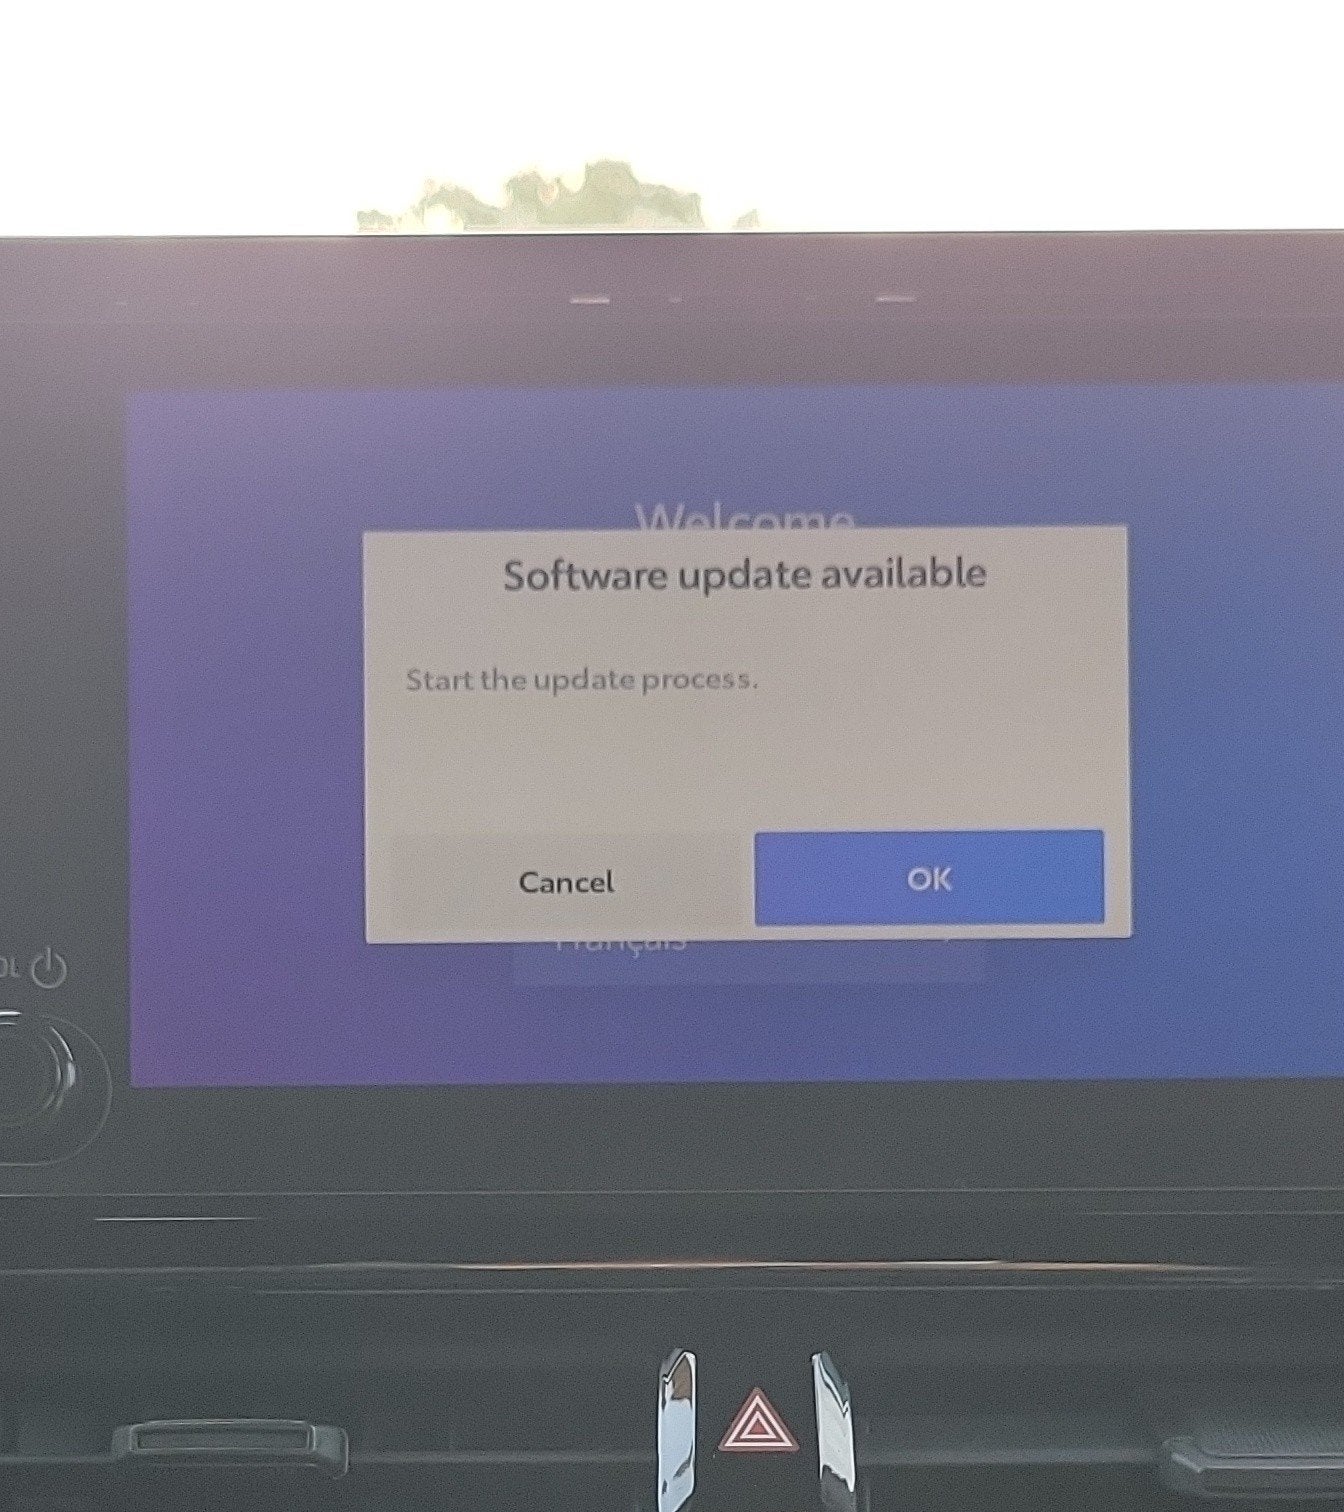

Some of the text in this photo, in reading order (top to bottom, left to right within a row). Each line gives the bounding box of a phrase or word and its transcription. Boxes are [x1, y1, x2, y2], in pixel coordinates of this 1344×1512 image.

[503, 554, 988, 597] Software update available
[405, 666, 760, 698] Start the update process.
[519, 868, 616, 895] Cancel
[906, 866, 953, 892] OK
